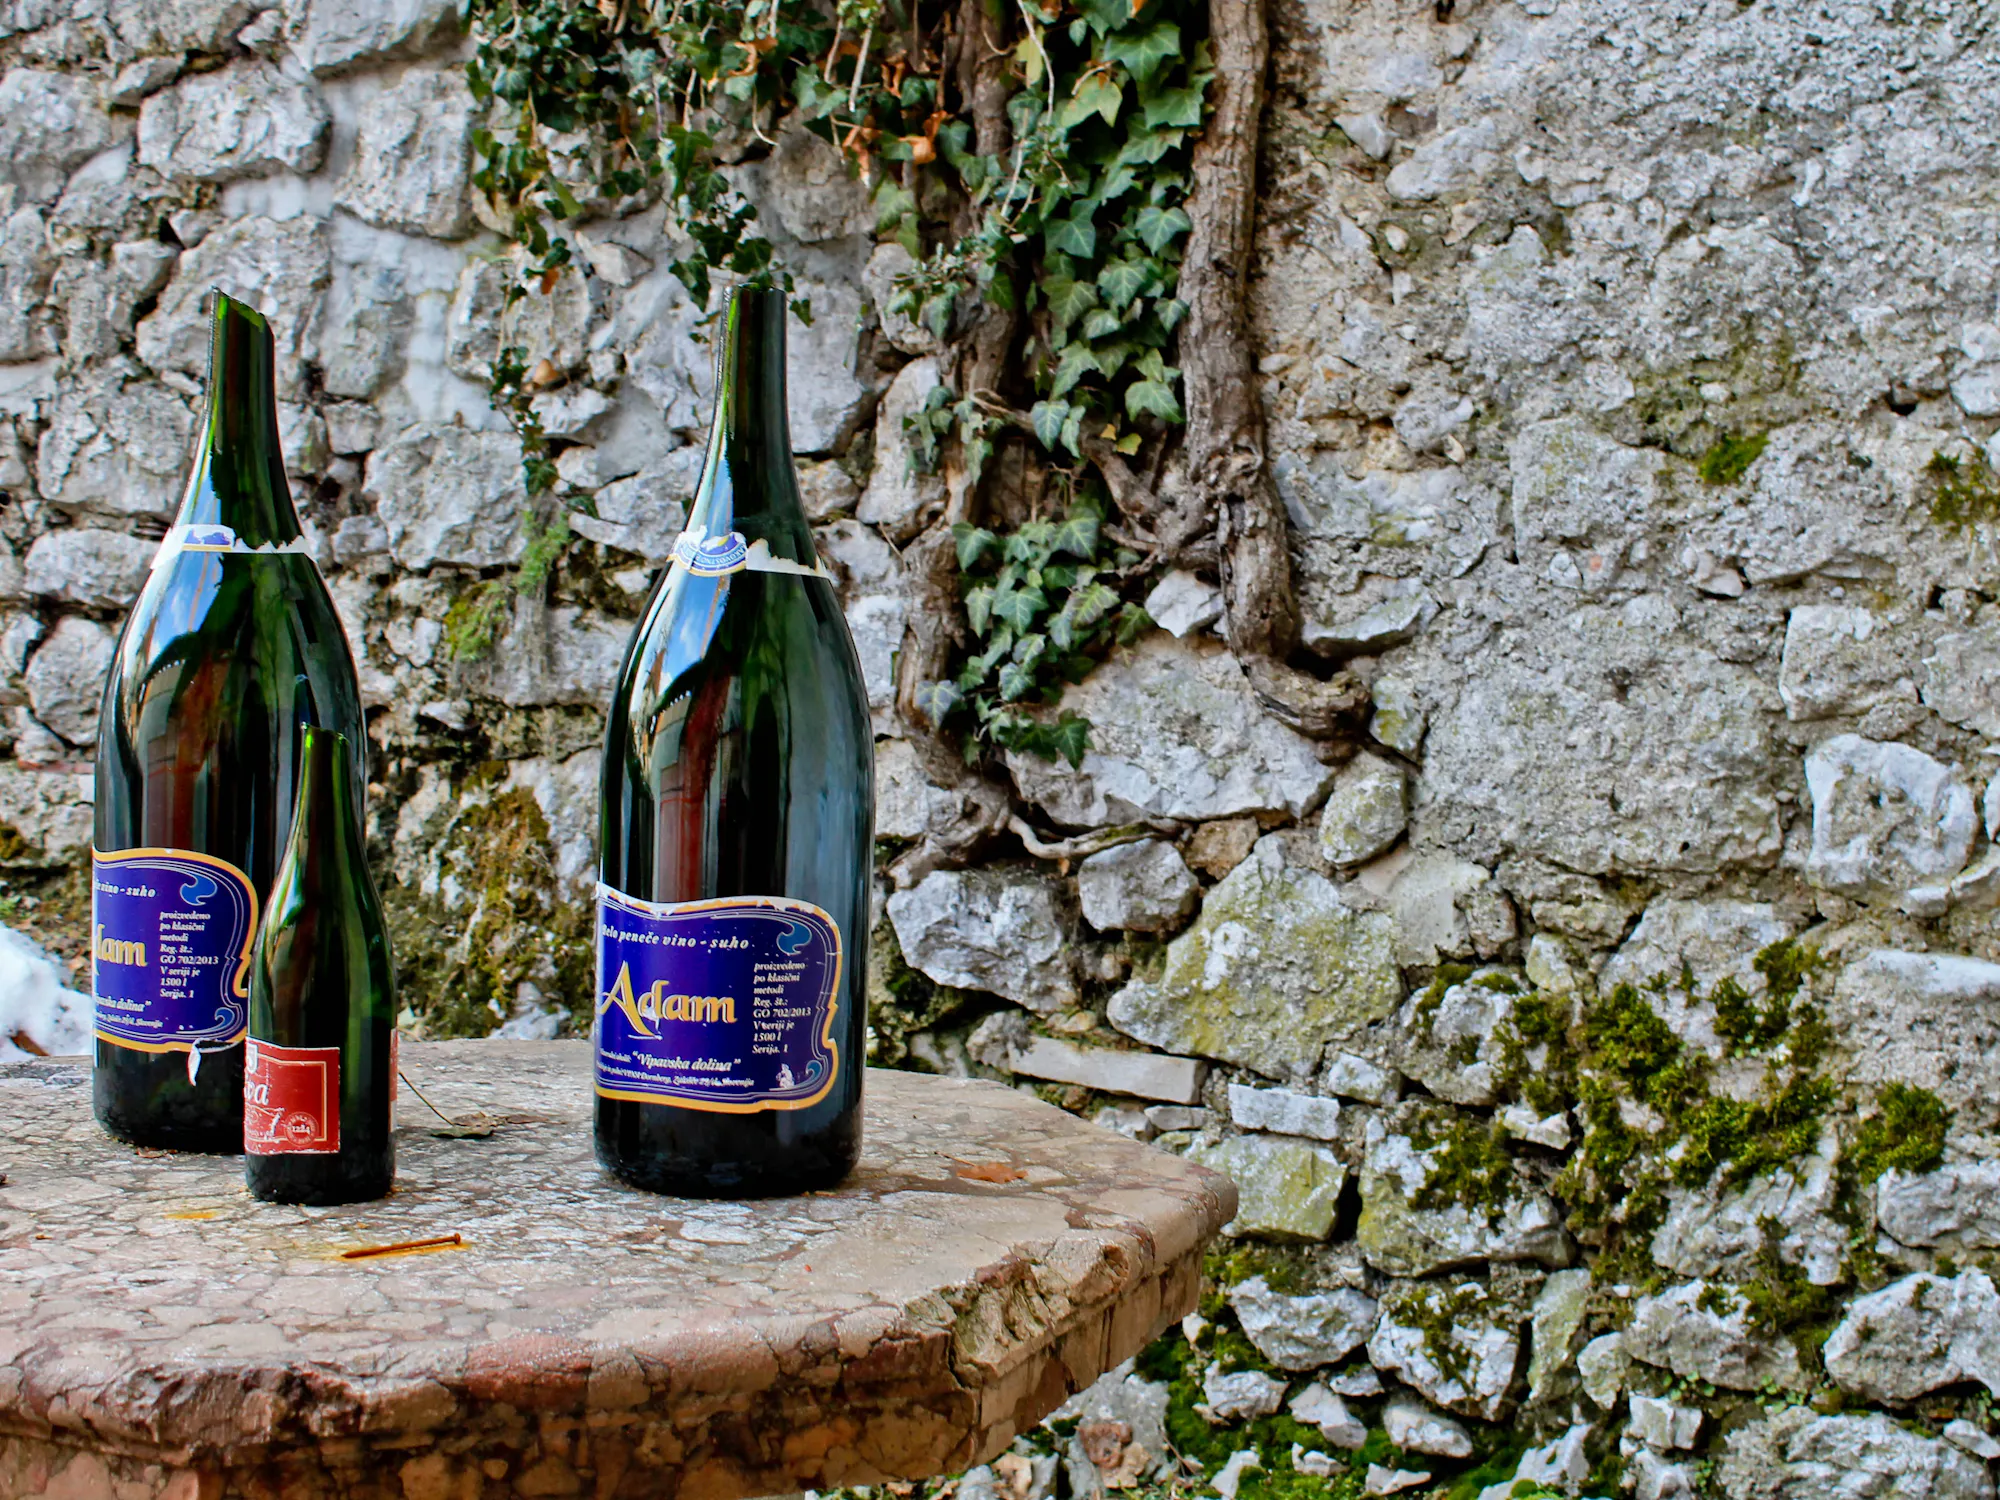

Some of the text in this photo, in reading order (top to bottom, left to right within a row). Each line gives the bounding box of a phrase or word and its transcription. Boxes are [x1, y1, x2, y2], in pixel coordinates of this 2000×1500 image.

[125, 885, 156, 898] suho
[159, 922, 171, 932] po
[95, 923, 148, 968] dam
[662, 933, 697, 948] vino
[709, 935, 749, 949] suho
[160, 955, 220, 965] GO 702/2013
[160, 966, 169, 975] V
[190, 966, 201, 978] je
[753, 960, 806, 973] proizvedeno
[160, 977, 182, 987] 1500
[753, 974, 766, 984] po
[188, 989, 194, 998] 1
[599, 959, 739, 1038] Adam
[753, 1007, 812, 1018] GO 702/2013
[785, 1019, 796, 1031] je
[753, 1032, 776, 1042] 1500
[783, 1043, 788, 1053] 1
